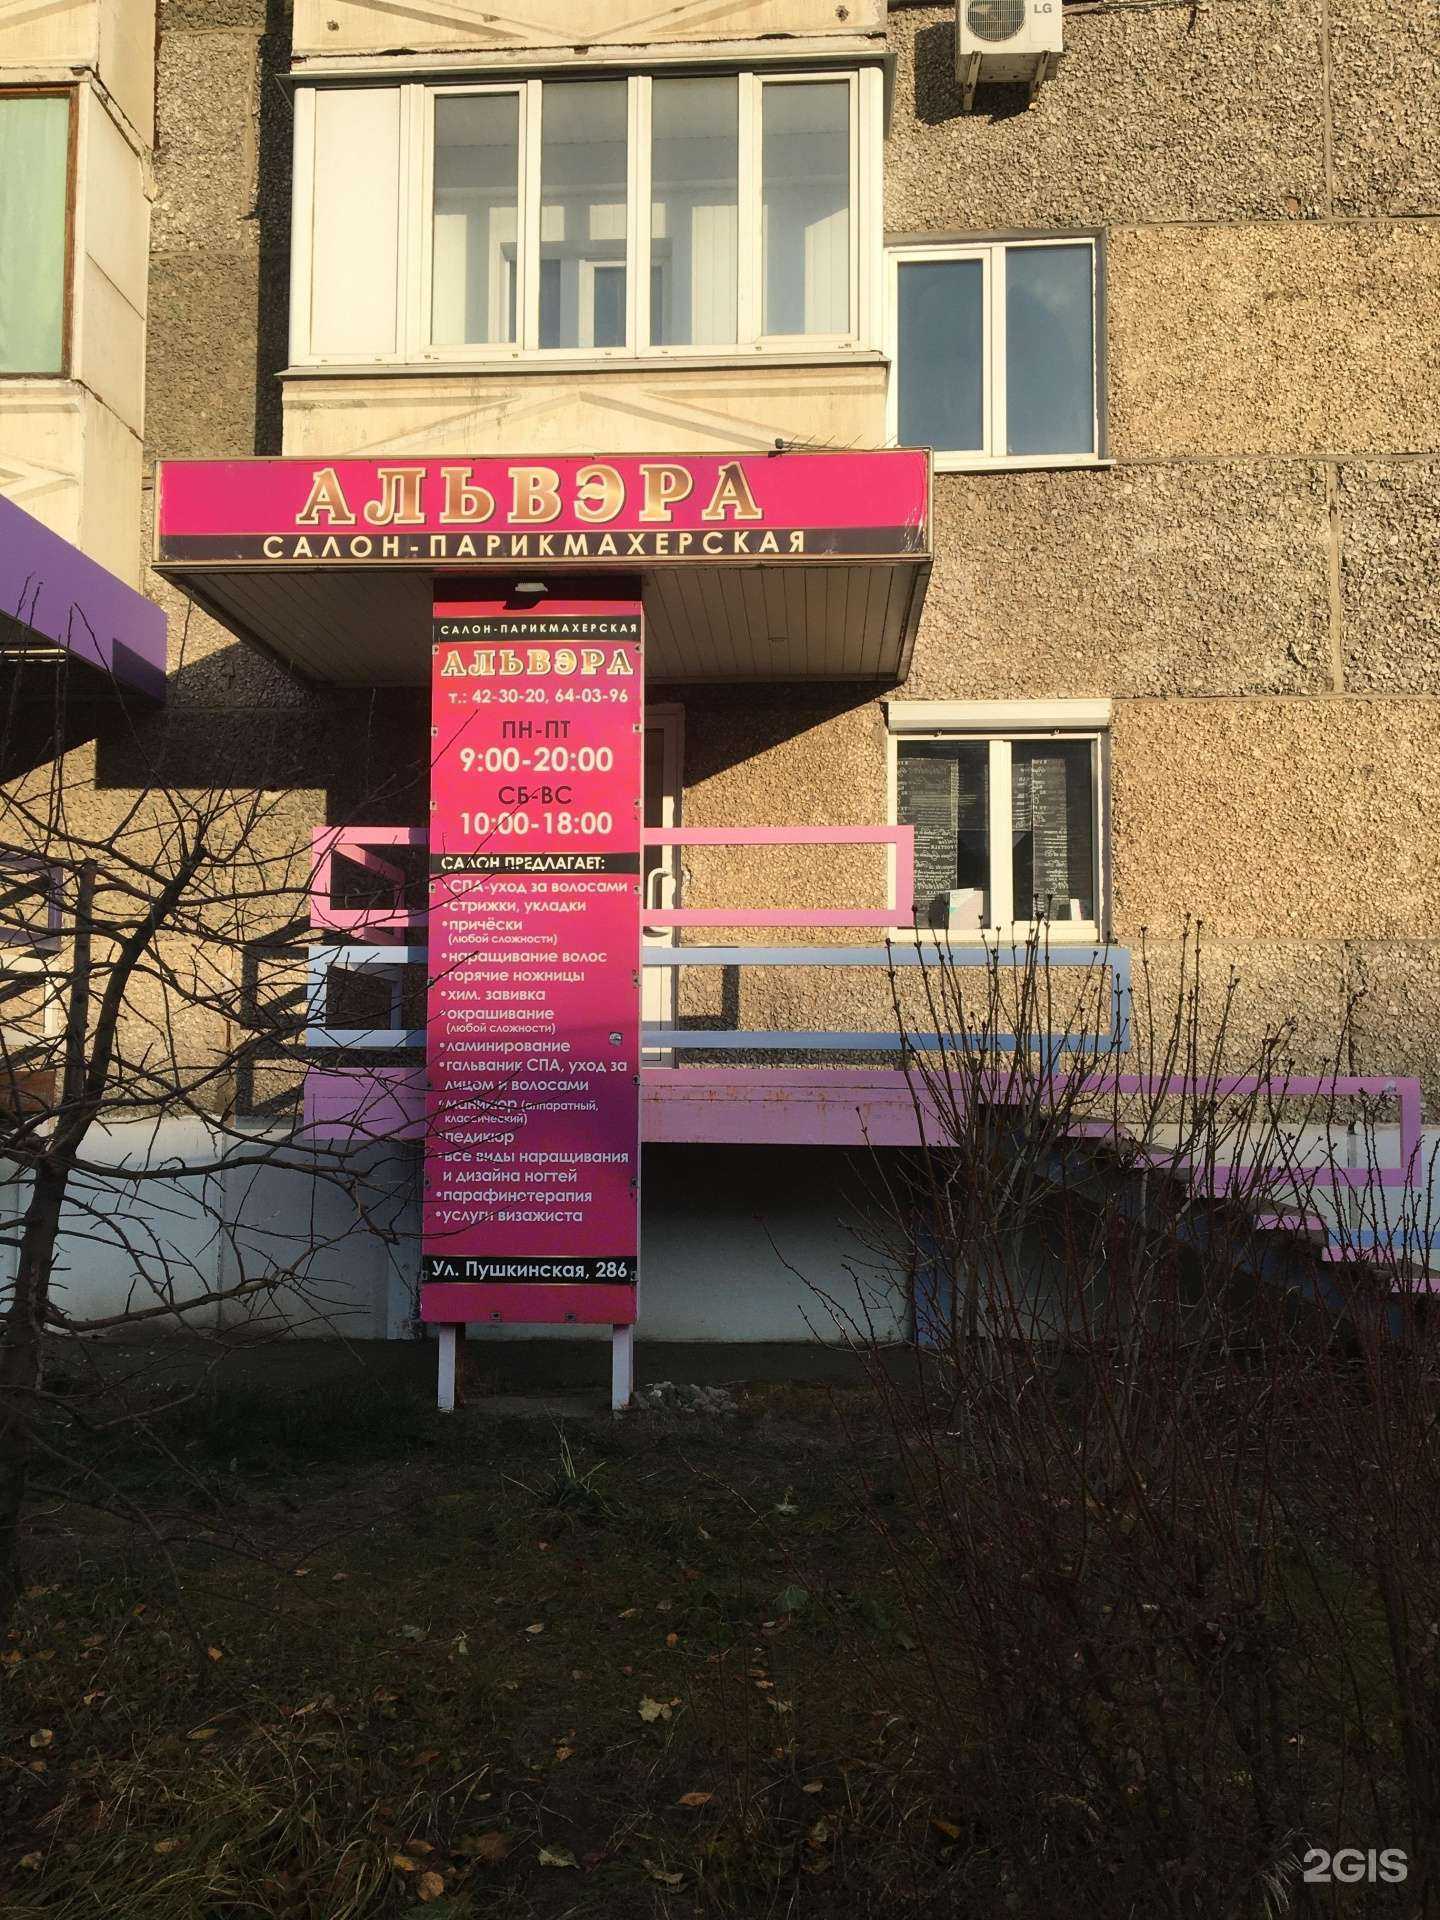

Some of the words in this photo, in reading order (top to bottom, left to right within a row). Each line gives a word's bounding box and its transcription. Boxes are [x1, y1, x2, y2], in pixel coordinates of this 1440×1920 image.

[1034, 3, 1052, 14] LG
[295, 461, 762, 526] АЛЬВЭРА
[262, 531, 806, 559] САЛОН-ПАРИКМАХЕРСКАЯ
[441, 623, 637, 634] САЛОН-ПАРИКМАХЕРСКАЯ
[441, 649, 634, 677] АЛЬВЭРА
[472, 689, 549, 705] 42-30-20,
[555, 688, 628, 703] 64-03-96
[502, 720, 571, 739] ПН-ПТ
[460, 747, 613, 772] 9:00-20:00
[498, 786, 572, 805] СБ-ВС
[461, 811, 613, 835] 10:00-18:00
[441, 856, 499, 870] САЛОН
[505, 856, 605, 871] ПРЕДЛАГАЕТ:
[450, 880, 527, 896] СПА-уход
[531, 881, 547, 892] за
[552, 882, 627, 893] волосами
[450, 901, 520, 914] стрижки,
[525, 901, 586, 914] укладки
[450, 917, 522, 933] причёски
[449, 933, 489, 946] (любой
[492, 934, 557, 946] сложности)
[449, 952, 558, 967] наращивание
[563, 952, 607, 963] волос
[448, 971, 509, 986] горячие
[513, 971, 585, 984] ножницы
[448, 990, 480, 1000] хим.
[486, 990, 545, 1001] завивка
[447, 1009, 554, 1023] окрашивание
[447, 1022, 487, 1035] (любой
[490, 1023, 556, 1035] сложности)
[447, 1041, 571, 1054] ламинирование
[527, 1059, 564, 1074] СПА,
[569, 1060, 607, 1076] уход
[610, 1060, 628, 1072] за
[512, 1079, 589, 1091] волосами
[444, 1152, 472, 1162] все
[519, 1151, 629, 1166] наращивания
[443, 1172, 452, 1183] и
[455, 1169, 520, 1184] дизайна
[525, 1168, 577, 1182] ногтей
[443, 1188, 592, 1204] парафинотерапия
[498, 1209, 583, 1222] визажиста
[432, 1260, 459, 1277] Ул.
[465, 1260, 590, 1281] Пушкинская,
[596, 1261, 627, 1278] 286
